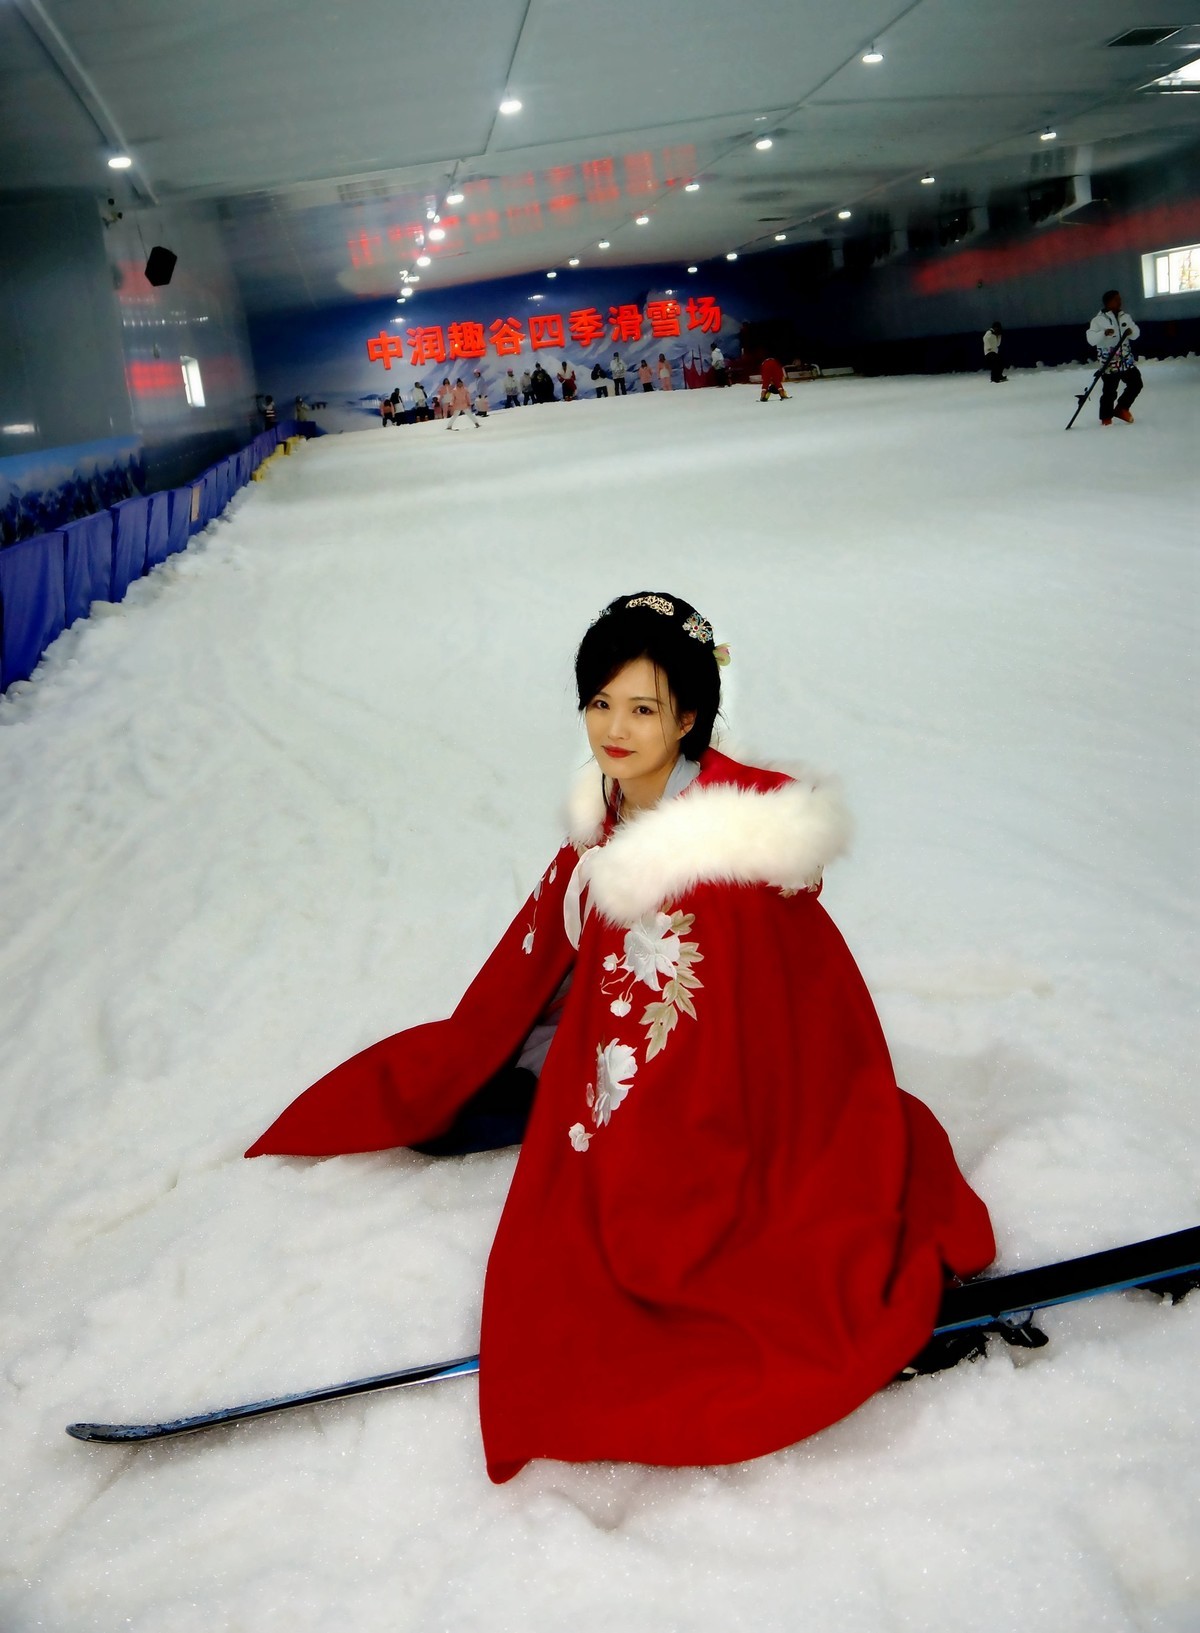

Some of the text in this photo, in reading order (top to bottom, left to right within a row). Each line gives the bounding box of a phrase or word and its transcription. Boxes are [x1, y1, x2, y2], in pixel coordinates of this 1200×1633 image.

[366, 295, 722, 370] 中润趣谷四季滑雪场
